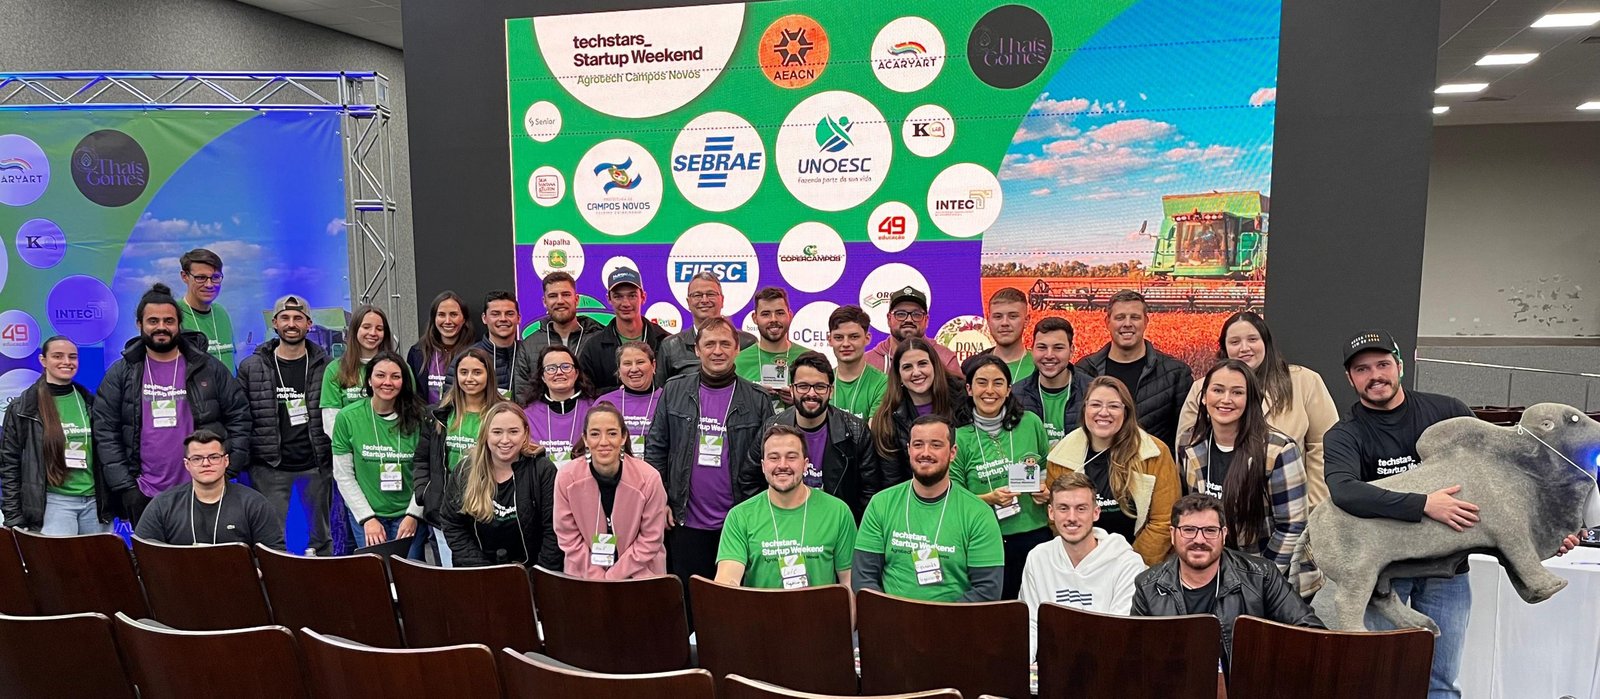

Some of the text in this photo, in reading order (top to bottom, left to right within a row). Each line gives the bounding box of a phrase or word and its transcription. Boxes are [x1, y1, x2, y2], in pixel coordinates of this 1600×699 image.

[573, 33, 652, 49] techstars_
[573, 46, 703, 67] Startup Weekend
[984, 51, 1046, 66] Gomes
[877, 58, 937, 70] ACARYART
[577, 73, 623, 87] Agrotech
[625, 71, 666, 84] Campos
[773, 69, 815, 81] AEACN
[535, 117, 555, 126] Senior
[912, 123, 930, 137] K
[673, 152, 762, 172] SEBRAE
[798, 158, 871, 173] UNOESC
[1, 175, 43, 183] ARYART
[86, 173, 145, 186] Gomes
[587, 201, 651, 211] CAMPOS NOVOS
[936, 199, 975, 210] INTEC
[878, 216, 906, 235] 49
[26, 235, 42, 249] K
[780, 254, 841, 262] COPERCAMPOS
[680, 264, 742, 281] FIESC
[55, 309, 93, 319] INTEC
[2, 324, 29, 341] 49
[956, 341, 984, 352] DONA
[711, 424, 727, 432] Week
[362, 450, 386, 458] Startup
[1376, 466, 1407, 475] Startup
[893, 530, 930, 543] techstars_
[761, 540, 801, 548] techstars_
[891, 538, 918, 548] Startup
[762, 545, 824, 556] Startup Weekend
